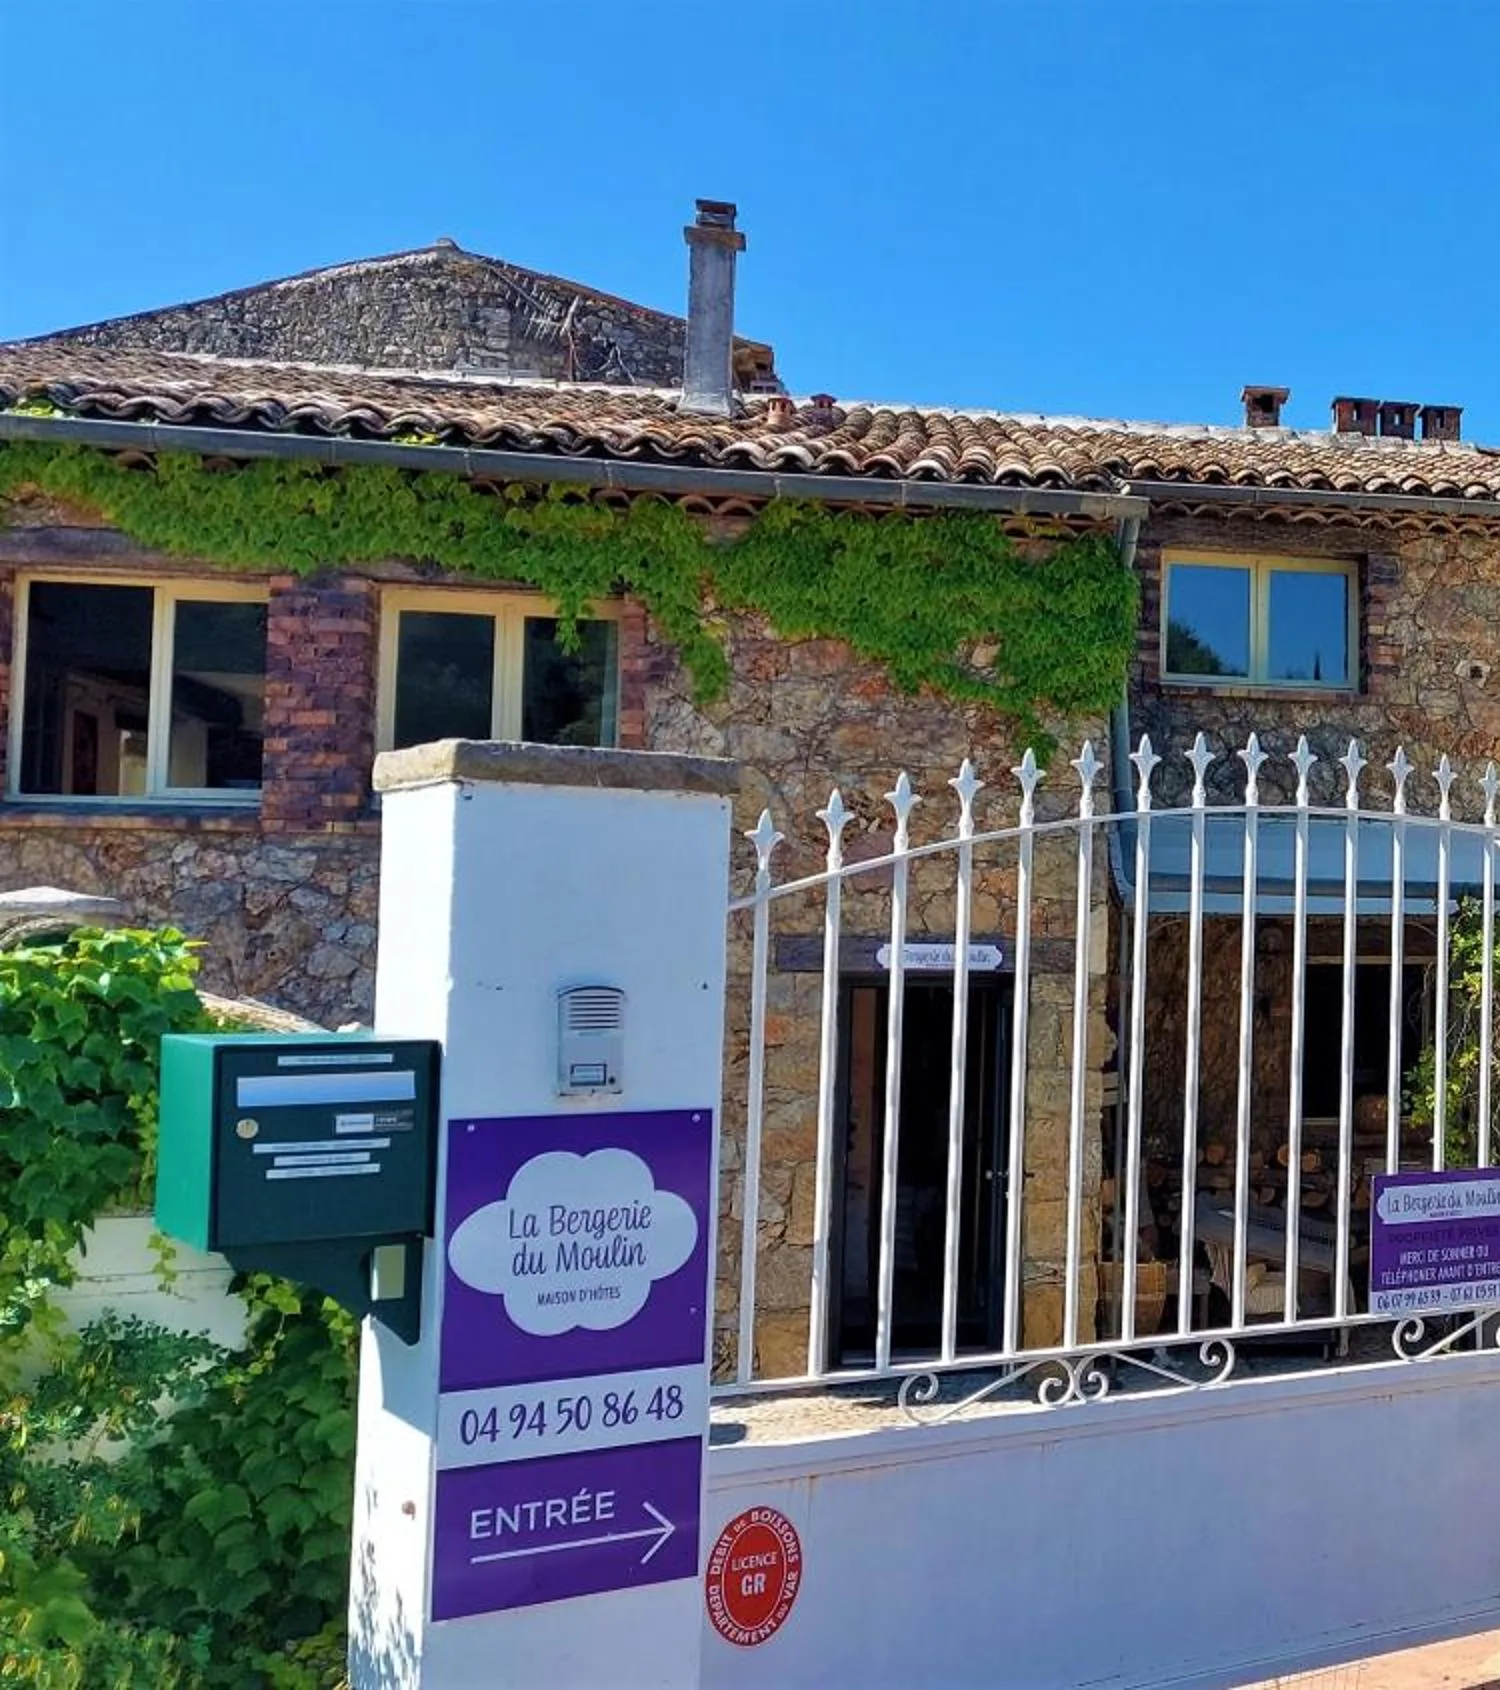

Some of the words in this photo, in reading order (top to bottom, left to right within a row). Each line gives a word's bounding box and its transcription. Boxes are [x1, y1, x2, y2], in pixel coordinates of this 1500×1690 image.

[1387, 1197, 1400, 1215] La
[1403, 1192, 1446, 1214] Bergerie
[1447, 1190, 1463, 1208] du
[509, 1209, 539, 1239] La
[550, 1201, 652, 1239] Bergerie
[512, 1243, 547, 1276] du
[556, 1235, 646, 1274] Moulin
[1400, 1250, 1425, 1265] MERCI
[1428, 1249, 1440, 1262] DE
[1441, 1246, 1474, 1260] SONNER
[1476, 1245, 1489, 1258] OU
[1381, 1267, 1437, 1285] TÉLÉPHONER
[1438, 1265, 1465, 1280] AVANT
[537, 1290, 576, 1306] MAISON
[579, 1285, 622, 1301] D'HÔTES
[460, 1407, 500, 1446] 04
[509, 1401, 547, 1439] 94
[556, 1396, 592, 1434] 50
[602, 1390, 639, 1428] 86
[646, 1384, 684, 1421] 48
[470, 1488, 616, 1539] ENTRÉE
[710, 1534, 733, 1575] DEBIT
[751, 1511, 800, 1563] BOISSONS
[732, 1551, 777, 1571] LICENCE
[741, 1573, 768, 1597] GR
[708, 1585, 777, 1643] DEPARTEMENT
[776, 1604, 789, 1620] DU
[783, 1570, 799, 1600] VAR
